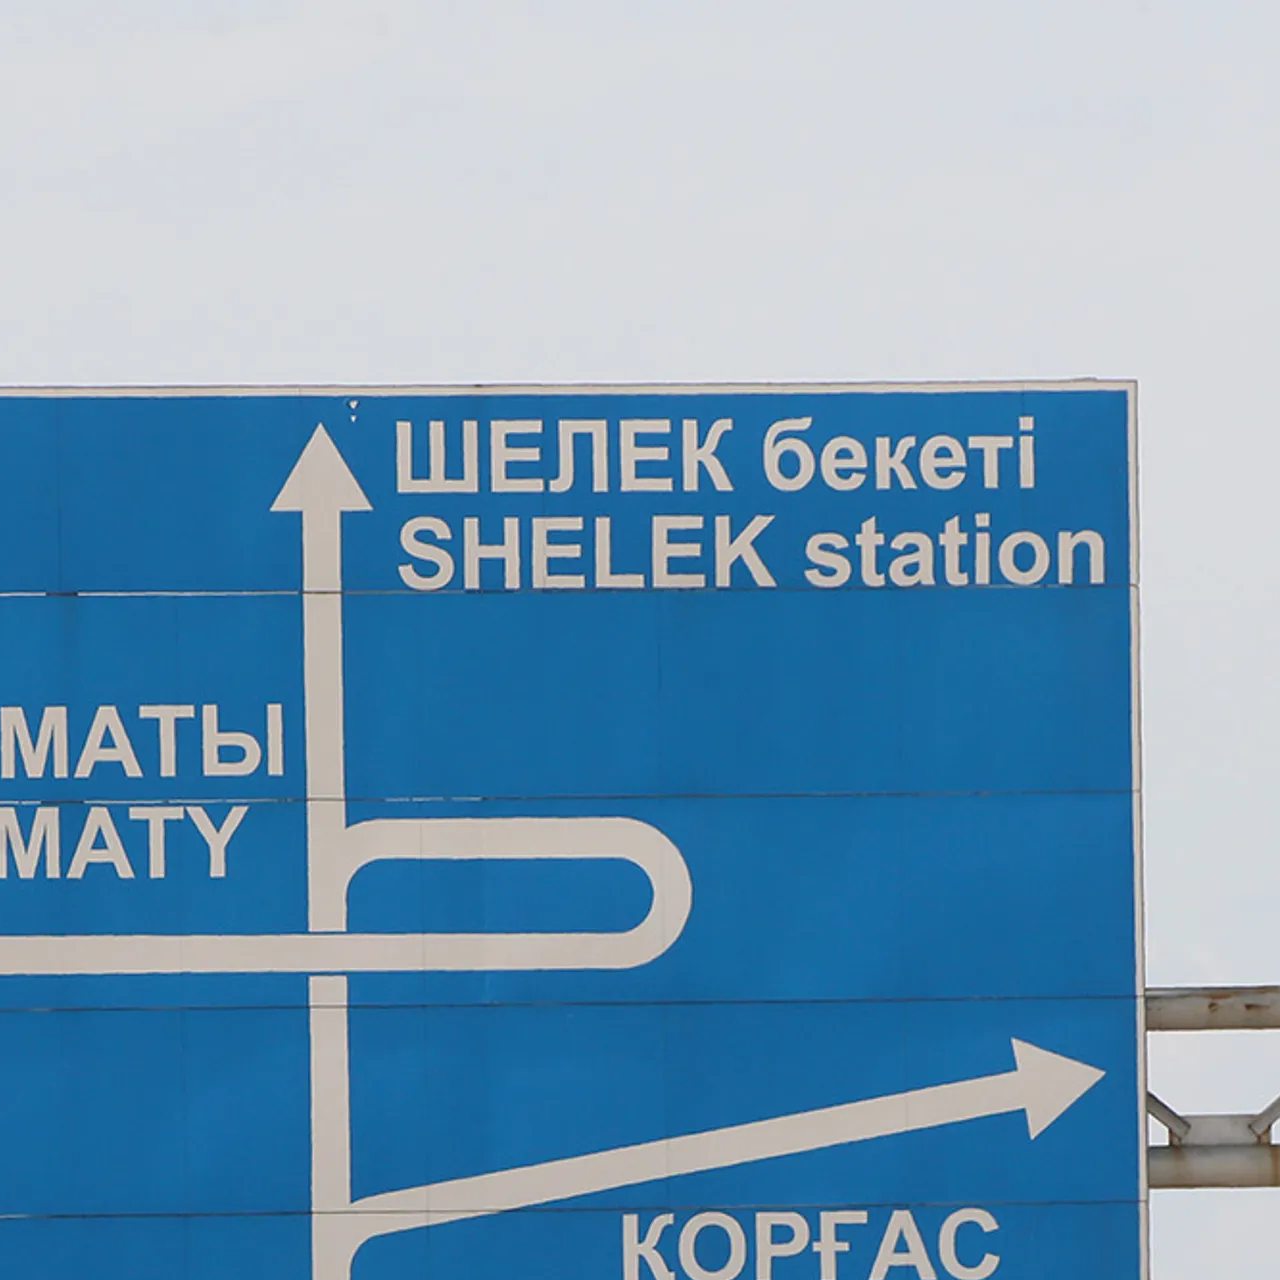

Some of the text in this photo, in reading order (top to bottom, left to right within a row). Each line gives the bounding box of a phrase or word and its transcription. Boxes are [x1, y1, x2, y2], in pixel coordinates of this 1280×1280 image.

[396, 416, 1034, 493] ШЕЛЕК бекеті
[399, 513, 1104, 588] SHELEK station
